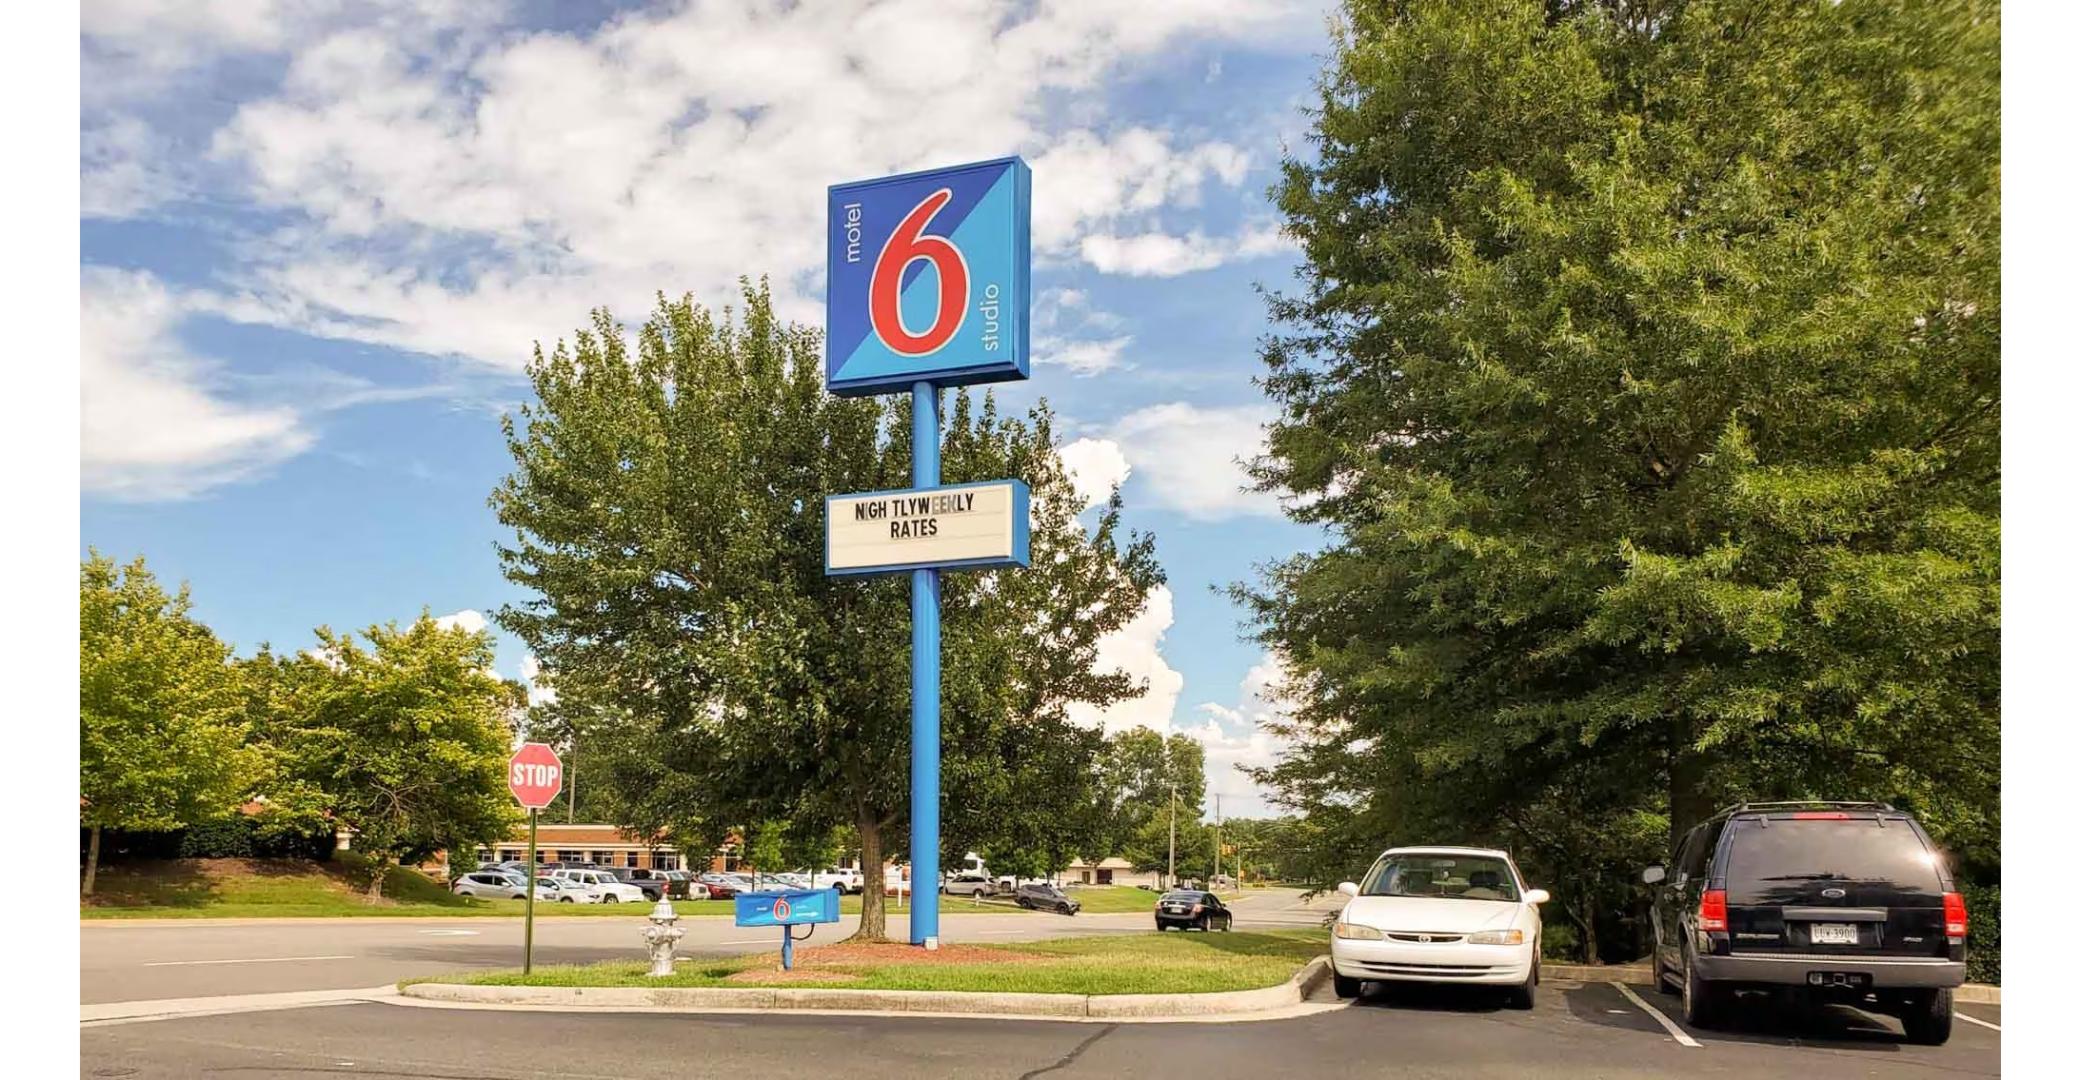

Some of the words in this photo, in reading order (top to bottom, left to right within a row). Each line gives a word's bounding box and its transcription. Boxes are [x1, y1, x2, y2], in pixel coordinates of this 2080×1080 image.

[844, 203, 861, 263] motel
[868, 188, 971, 358] 6
[980, 283, 999, 351] studio
[890, 518, 938, 538] RATES
[513, 762, 559, 787] STOP
[773, 895, 791, 921] 6
